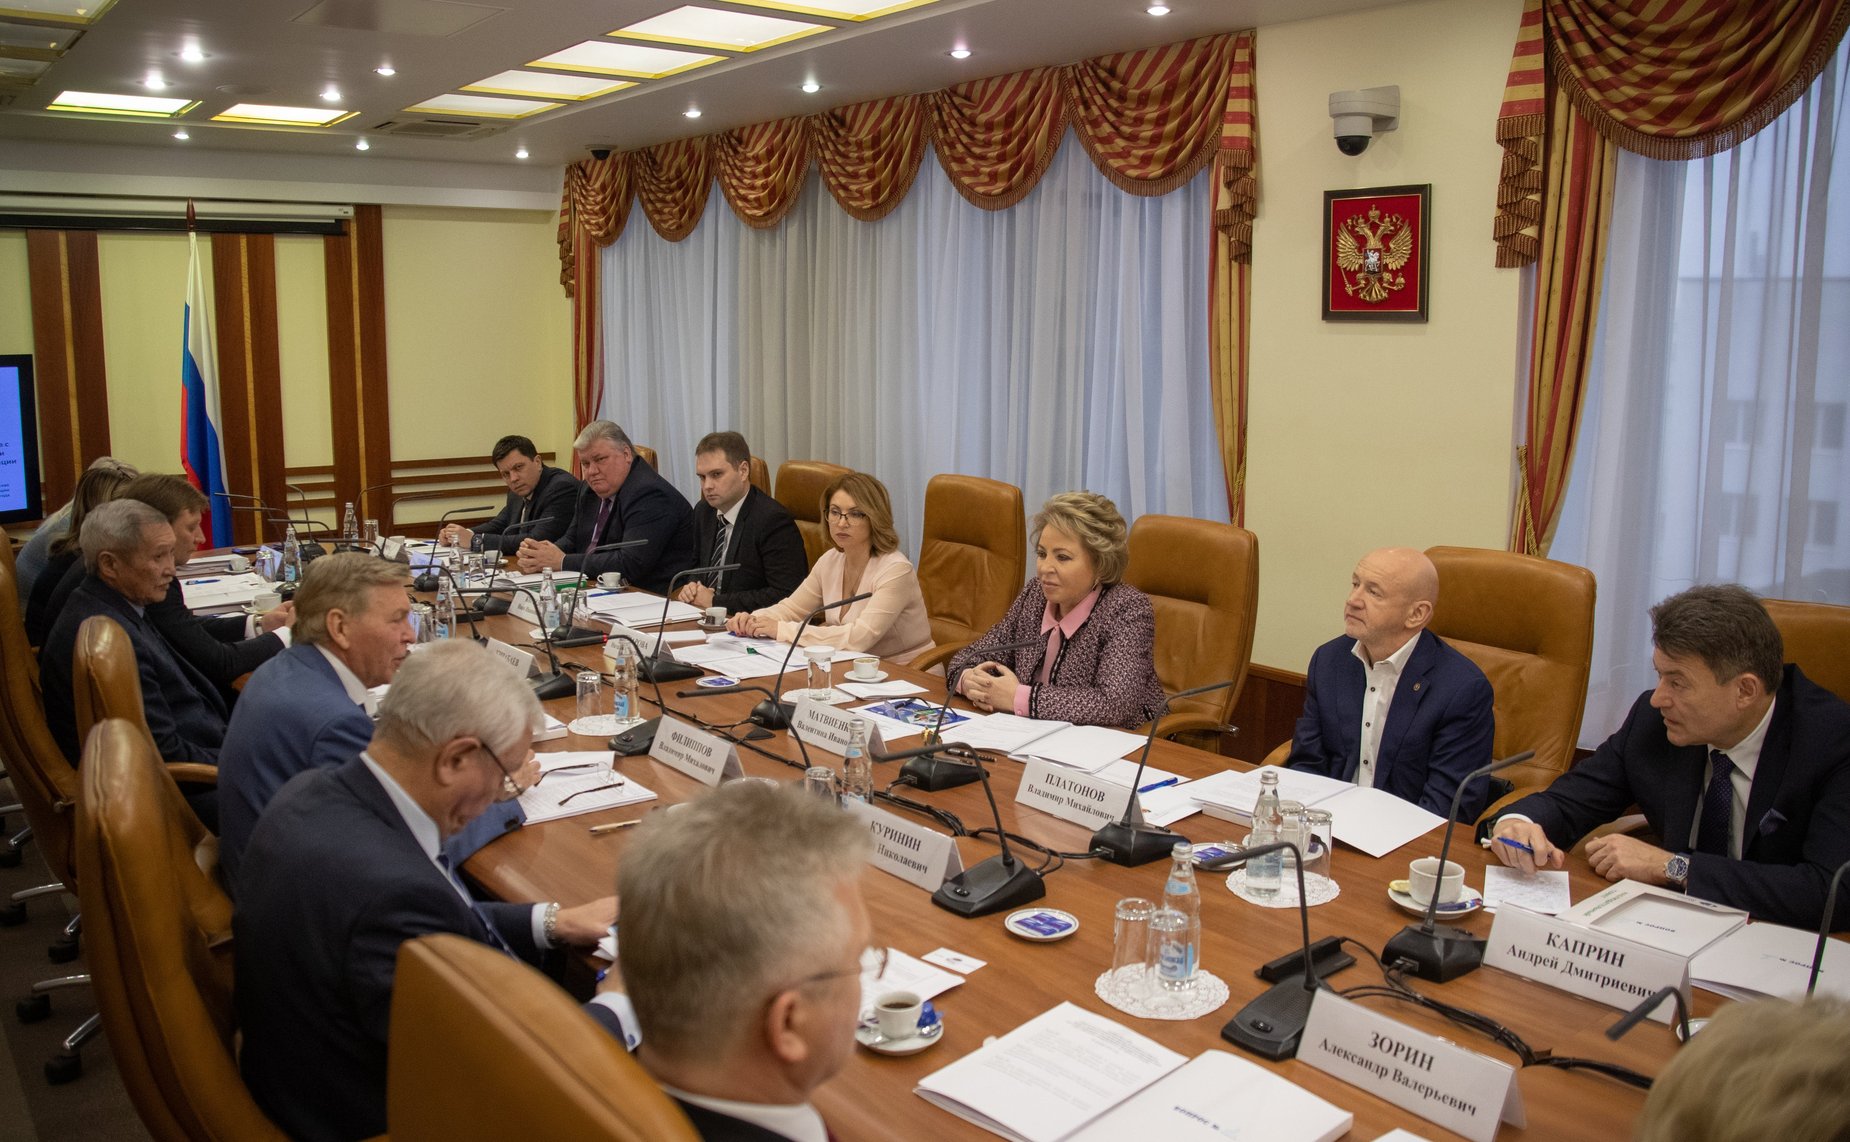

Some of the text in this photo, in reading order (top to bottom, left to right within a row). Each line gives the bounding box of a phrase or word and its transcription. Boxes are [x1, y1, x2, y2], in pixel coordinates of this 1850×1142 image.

[809, 709, 849, 733] МАТВИЕНК
[671, 731, 713, 757] ФИЛИППОВ
[828, 731, 848, 746] Ивано
[1045, 773, 1105, 802] ПЛАТОНОВ
[1027, 784, 1115, 822] Владимир Михайлович
[877, 843, 928, 874] Николаевич
[1507, 944, 1559, 969] Андрей
[1546, 932, 1625, 968] КАПРИН
[1368, 1031, 1435, 1072] ЗОРИН
[1318, 1038, 1477, 1117] Александр Валерьевич
